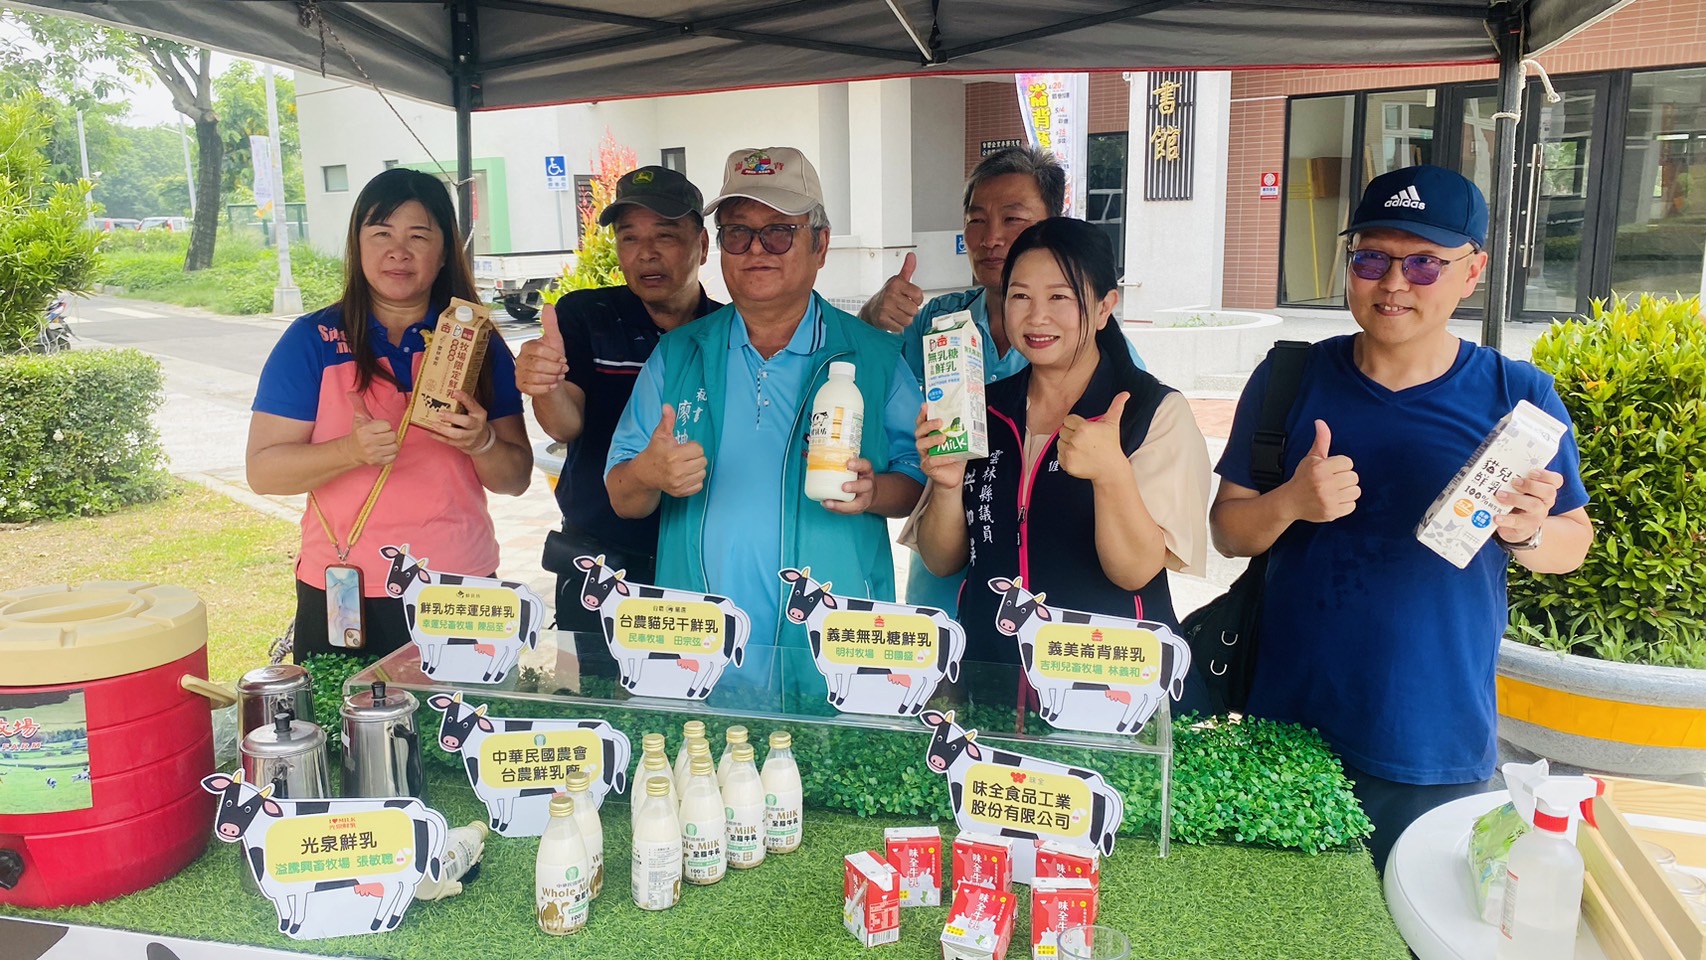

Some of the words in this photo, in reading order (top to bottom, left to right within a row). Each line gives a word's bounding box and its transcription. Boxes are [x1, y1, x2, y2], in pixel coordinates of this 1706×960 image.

[1384, 199, 1426, 210] adidas
[928, 347, 959, 364] 無乳糖
[935, 362, 957, 374] 鮮乳
[978, 449, 1004, 544] 雲林縣議員
[420, 602, 515, 618] 鮮乳坊幸運兒鮮乳
[620, 614, 718, 633] 台農貓兒干鮮乳
[827, 628, 932, 647] 義美無乳糖鮮乳
[1048, 641, 1146, 663] 義美崙背鮮乳
[492, 745, 588, 765] 中華民國農會
[972, 780, 1072, 810] 味全食品工業
[971, 799, 1070, 830] 股份有限公司
[301, 831, 378, 855] 光泉鮮乳
[542, 887, 576, 898] Whole
